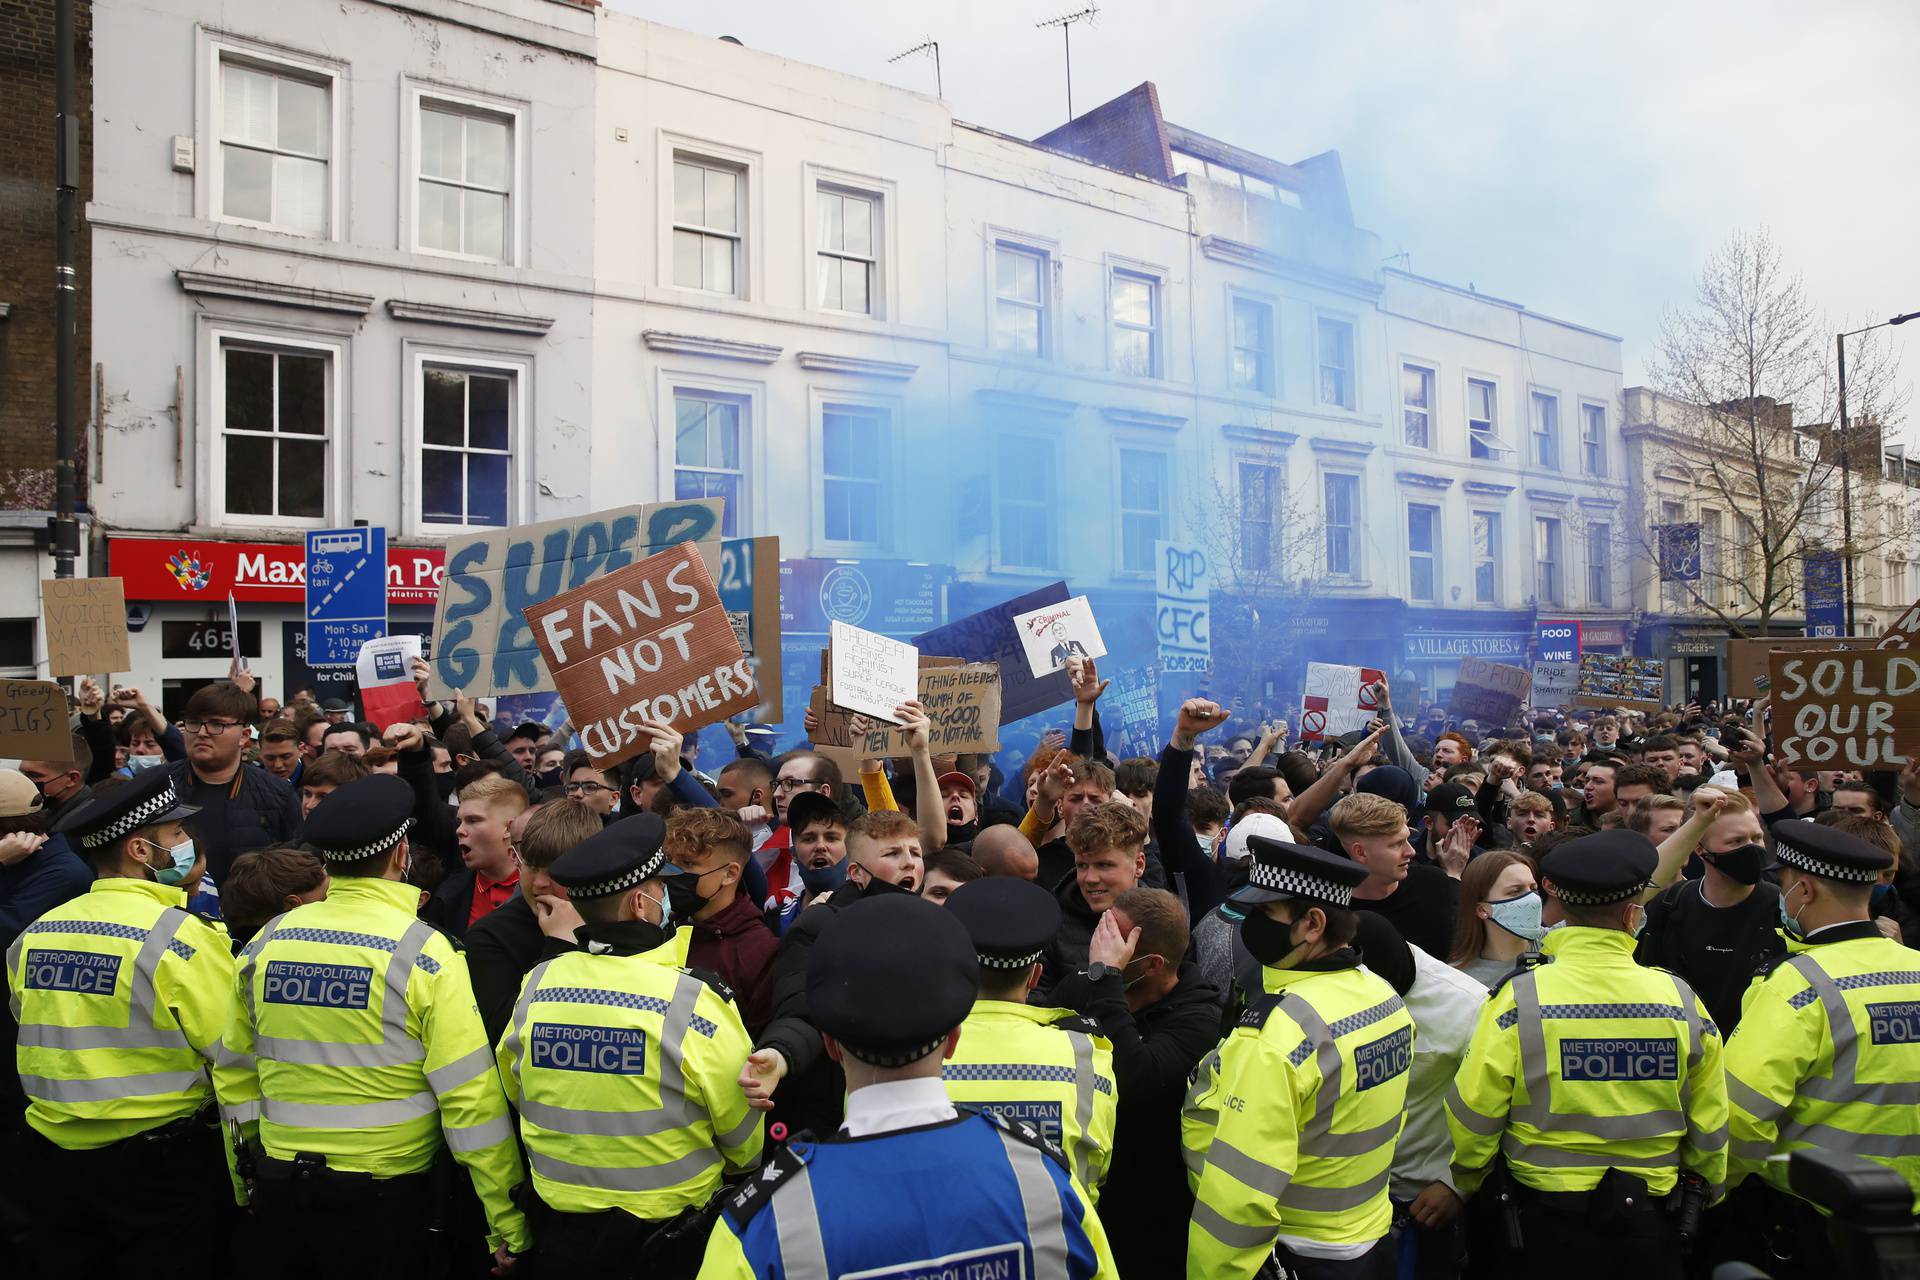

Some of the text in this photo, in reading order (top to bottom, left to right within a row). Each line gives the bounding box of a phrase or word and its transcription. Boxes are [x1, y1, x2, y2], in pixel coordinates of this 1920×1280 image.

[720, 543, 752, 592] 21
[1165, 547, 1205, 593] RIP
[53, 581, 100, 600] OUR
[312, 577, 330, 587] taxi
[48, 603, 112, 624] VOICE
[541, 560, 699, 664] FANS
[1038, 610, 1071, 624] CRIMINAL
[325, 625, 345, 635] Mon
[352, 624, 368, 634] Sat
[1158, 607, 1207, 644] CFC
[1542, 629, 1571, 638] FOOD
[1817, 626, 1834, 636] NO
[188, 629, 233, 650] 465
[840, 624, 905, 659] CHELSEA
[1419, 639, 1512, 655] VILLAGE STORES
[599, 622, 693, 696] NOT
[845, 652, 896, 675] AGAINST
[852, 645, 884, 663] FANS
[1543, 651, 1572, 660] WINE
[317, 672, 330, 681] for
[1310, 665, 1359, 696] SAY
[1537, 667, 1566, 677] PRIDE
[1780, 656, 1920, 700] SOLD
[7, 682, 50, 705] Greedy
[876, 680, 907, 694] LEAGUE
[926, 673, 957, 693] THING
[1535, 686, 1563, 695] SHAME
[580, 658, 755, 759] CUSTOMERS
[957, 692, 976, 704] OF
[940, 705, 981, 727] GOOD
[1794, 702, 1895, 737] OUR
[862, 730, 889, 754] MEN
[929, 729, 942, 743] DO
[1781, 735, 1909, 766] SOUL
[28, 952, 118, 969] METROPOLITAN
[26, 965, 114, 992] POLICE
[267, 963, 370, 981] METROPOLITAN
[265, 976, 367, 1006] POLICE
[1869, 1004, 1920, 1017] METROPO
[533, 1026, 643, 1044] METROPOLITAN
[1872, 1018, 1920, 1042] POL
[533, 1040, 642, 1071] POLICE
[1356, 1028, 1411, 1062] METROPOLITAN
[1562, 1041, 1676, 1053] METROPOLITAN
[1357, 1042, 1411, 1088] POLICE
[1564, 1055, 1677, 1078] POLICE
[982, 1104, 1059, 1118] OPOLITAN
